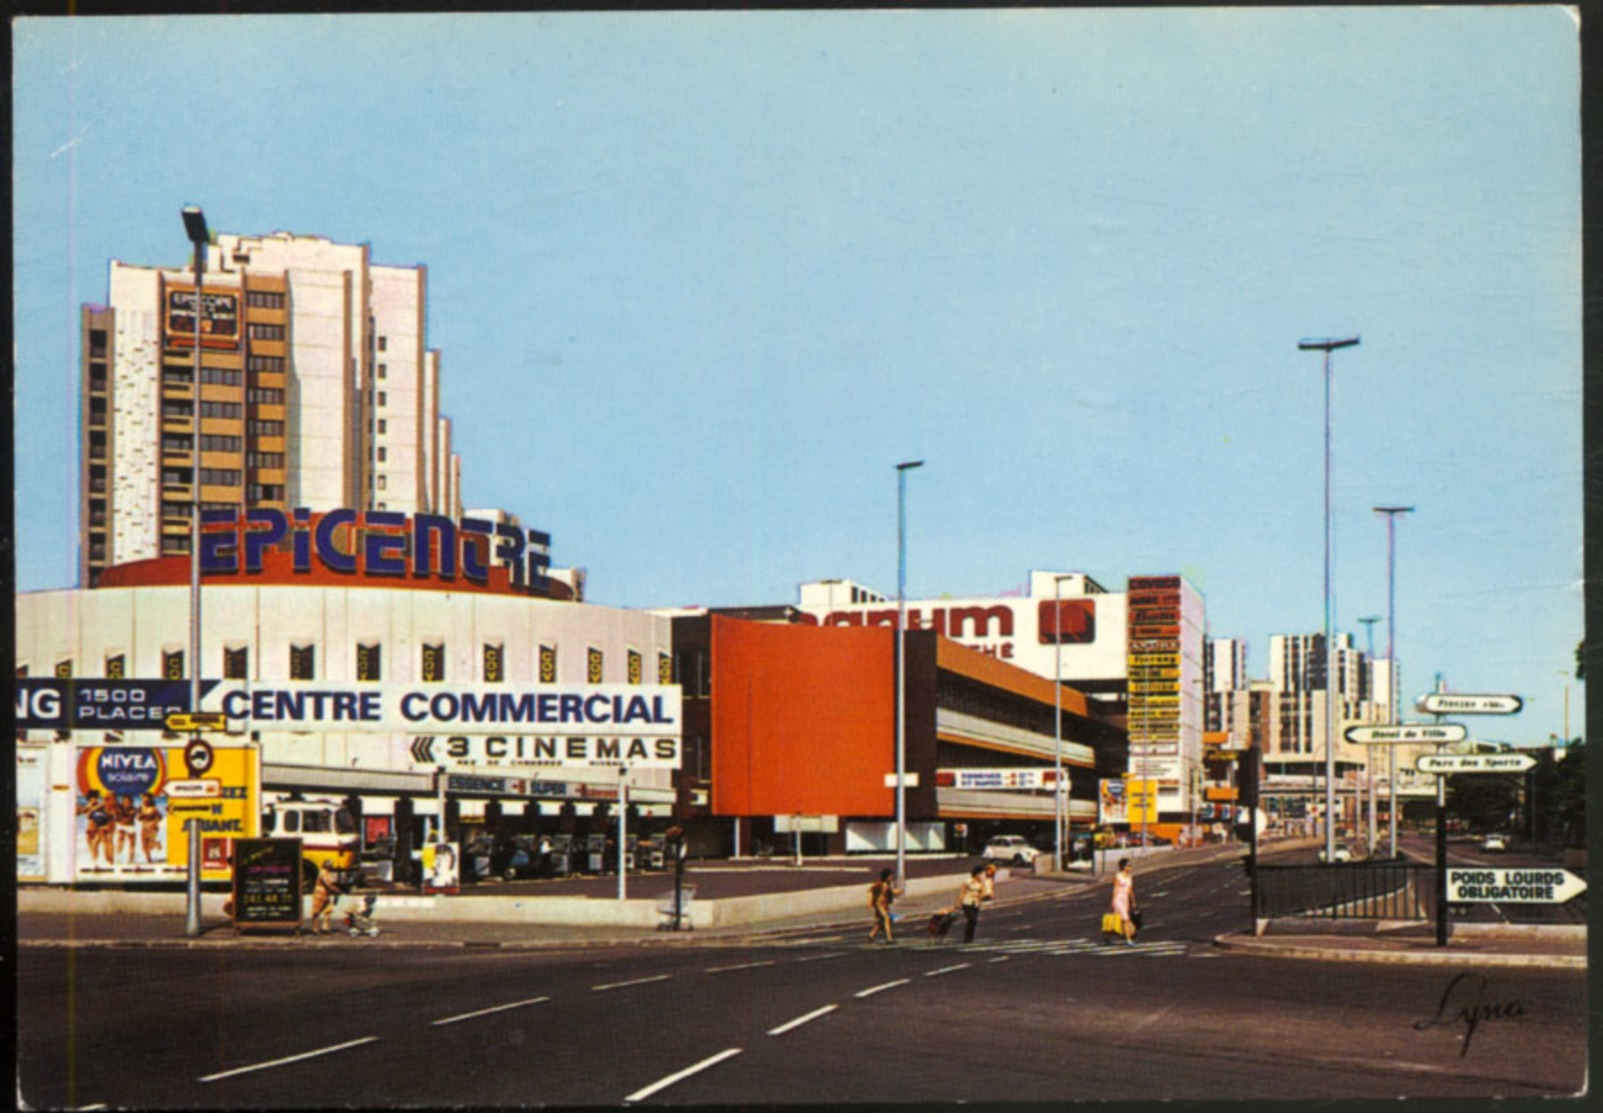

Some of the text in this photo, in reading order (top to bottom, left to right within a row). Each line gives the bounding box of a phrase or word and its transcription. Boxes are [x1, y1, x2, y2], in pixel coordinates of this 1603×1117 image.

[79, 689, 147, 702] 1500
[222, 690, 381, 721] CENTRE
[400, 691, 675, 724] COMMERCIAL
[446, 735, 677, 761] 3 CINEMAS
[101, 753, 158, 769] NIVEA
[1429, 758, 1454, 767] Parc
[1451, 872, 1565, 885] POIDS LOURDS
[1457, 886, 1554, 900] OBLIGATOIRE
